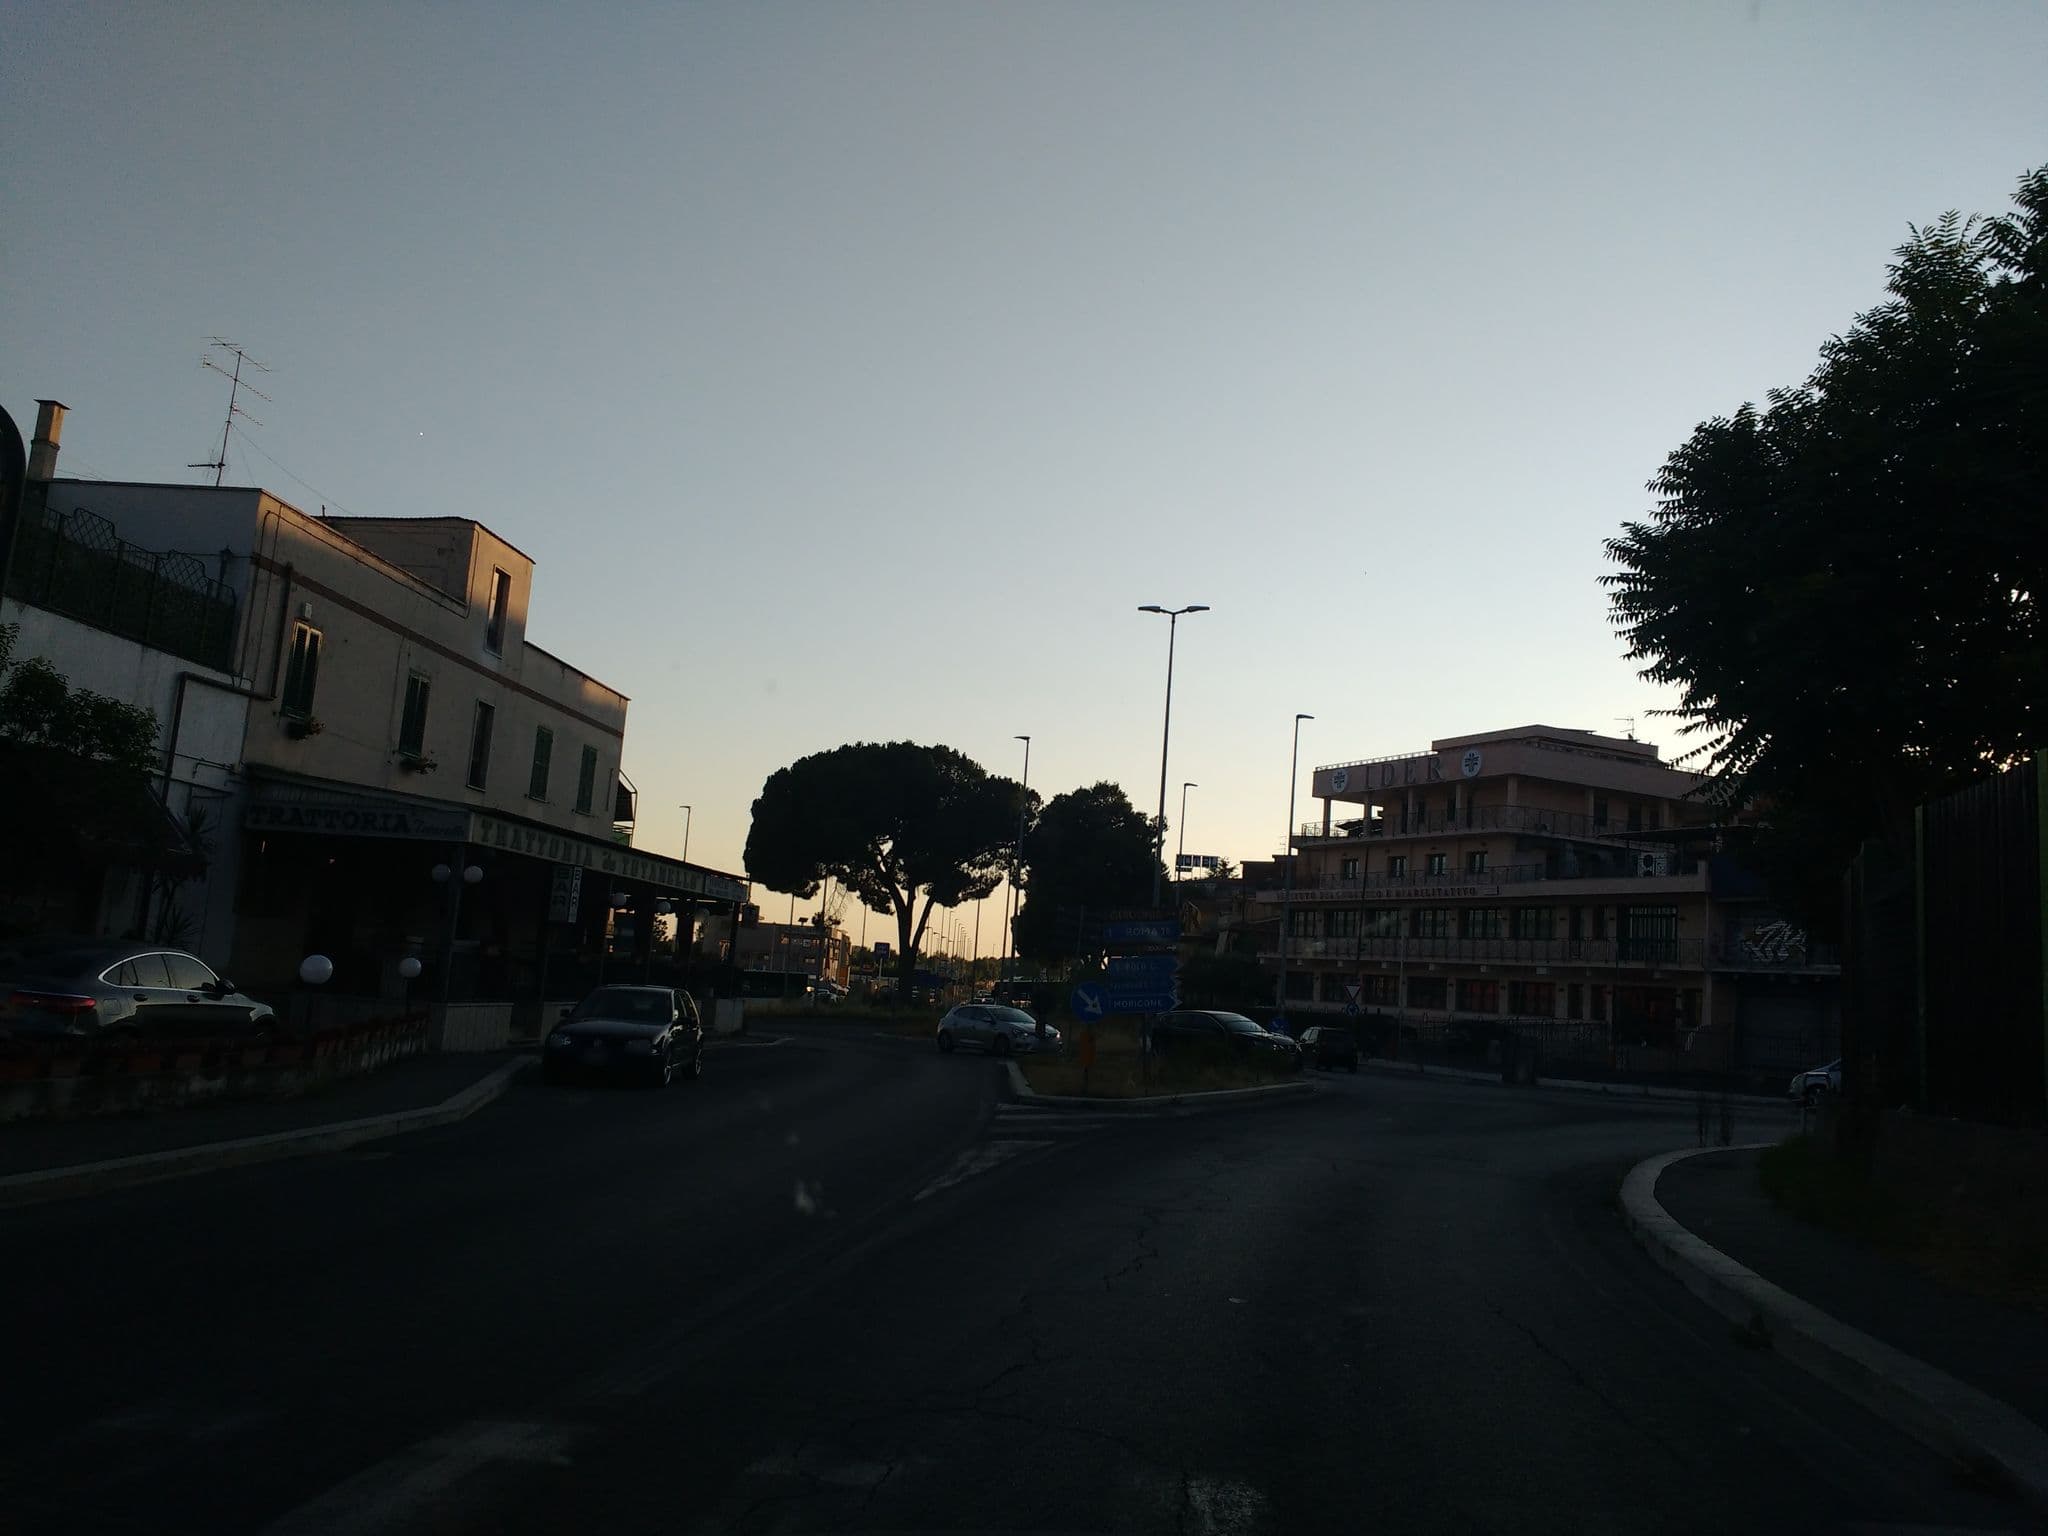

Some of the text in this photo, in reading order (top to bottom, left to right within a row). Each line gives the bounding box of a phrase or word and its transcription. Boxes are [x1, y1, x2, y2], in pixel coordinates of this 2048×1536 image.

[1365, 757, 1445, 790] IDER
[250, 806, 410, 834] TRATTORIA
[480, 815, 592, 867] TRATTORIA
[572, 869, 581, 906] BAR
